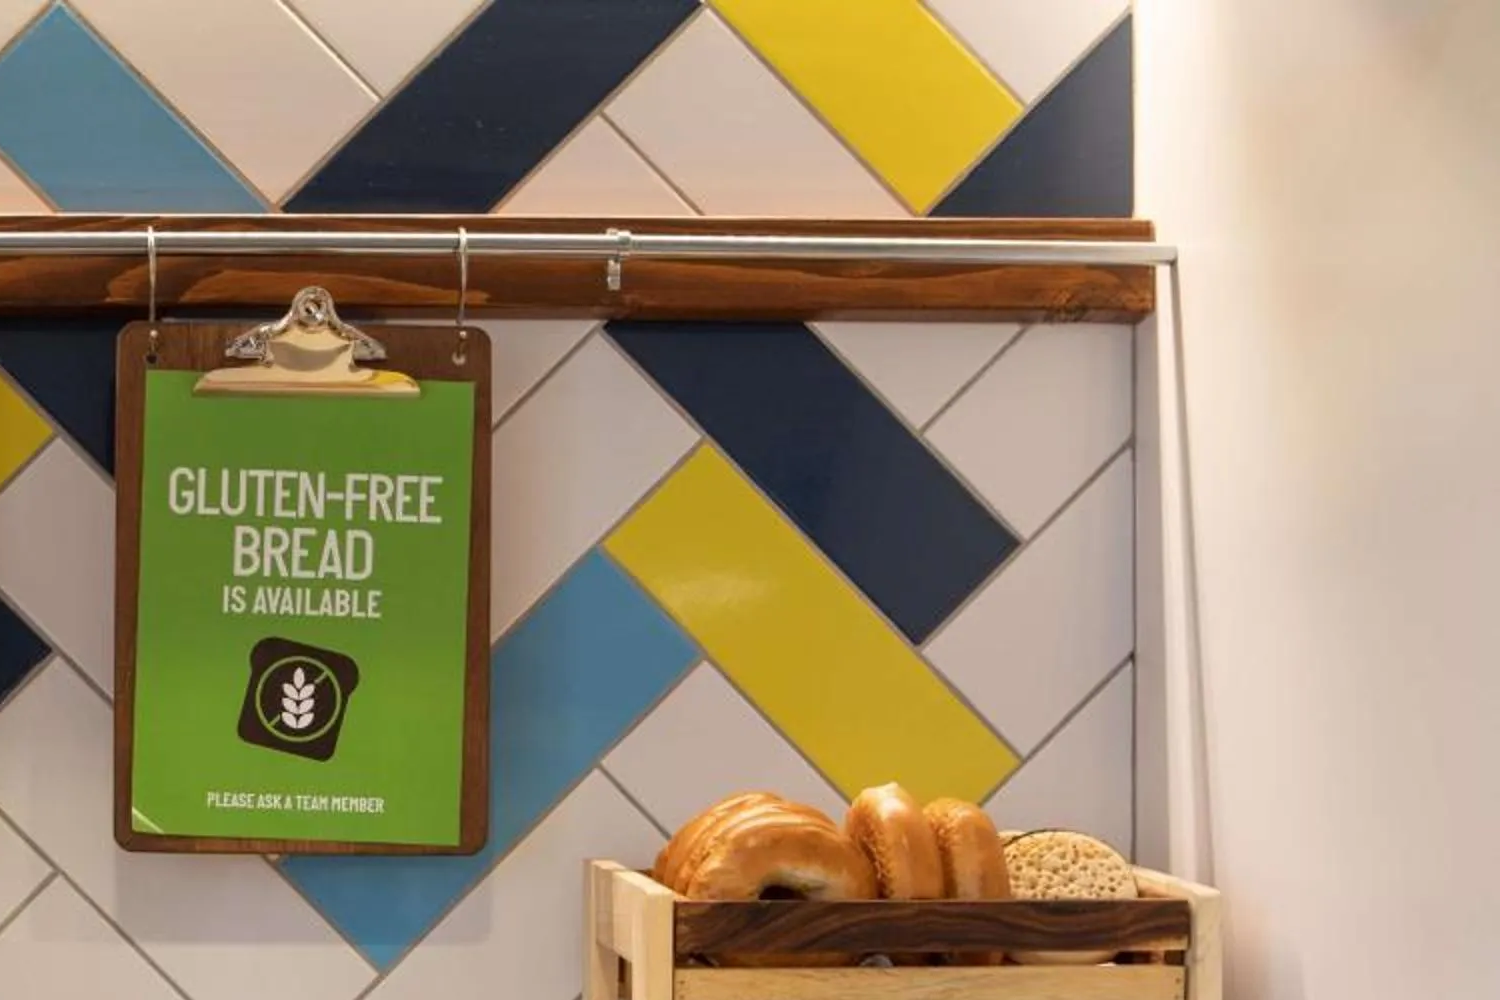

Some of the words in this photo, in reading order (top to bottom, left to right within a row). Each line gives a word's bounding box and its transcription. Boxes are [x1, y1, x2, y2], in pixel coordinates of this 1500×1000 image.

[168, 466, 443, 524] GLUTEN-FREE
[233, 526, 374, 581] BREAD
[223, 585, 247, 614] IS
[252, 586, 383, 618] AVAILABLE
[207, 791, 255, 809] PLEASE
[257, 794, 282, 810] ASK
[284, 795, 294, 810] A
[295, 795, 329, 811] TEAM
[331, 796, 385, 813] MEMBER
